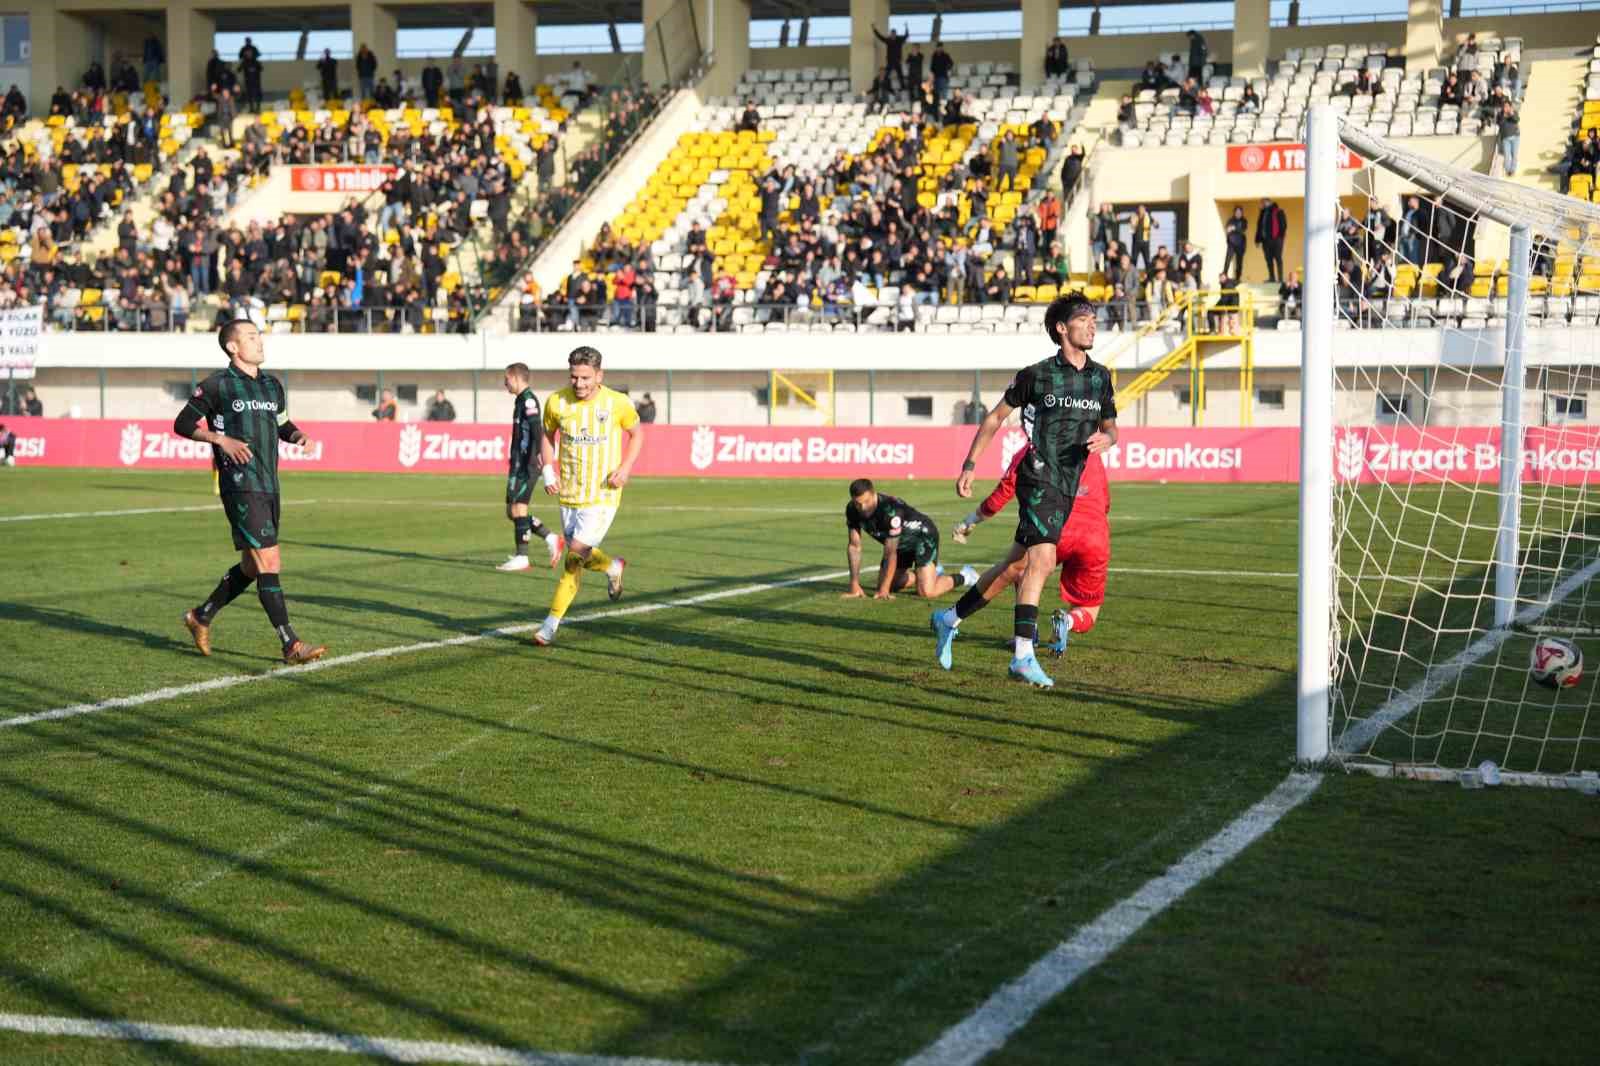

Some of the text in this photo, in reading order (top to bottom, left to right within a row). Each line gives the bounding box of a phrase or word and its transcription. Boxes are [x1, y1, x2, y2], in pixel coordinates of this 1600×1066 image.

[1268, 150, 1280, 169] A
[143, 433, 213, 460] Ziraa
[423, 433, 504, 460] Ziraat
[717, 434, 914, 465] Ziraat Bankası
[1126, 441, 1242, 469] Bankası
[1368, 441, 1600, 471] Ziraat Bnkası
